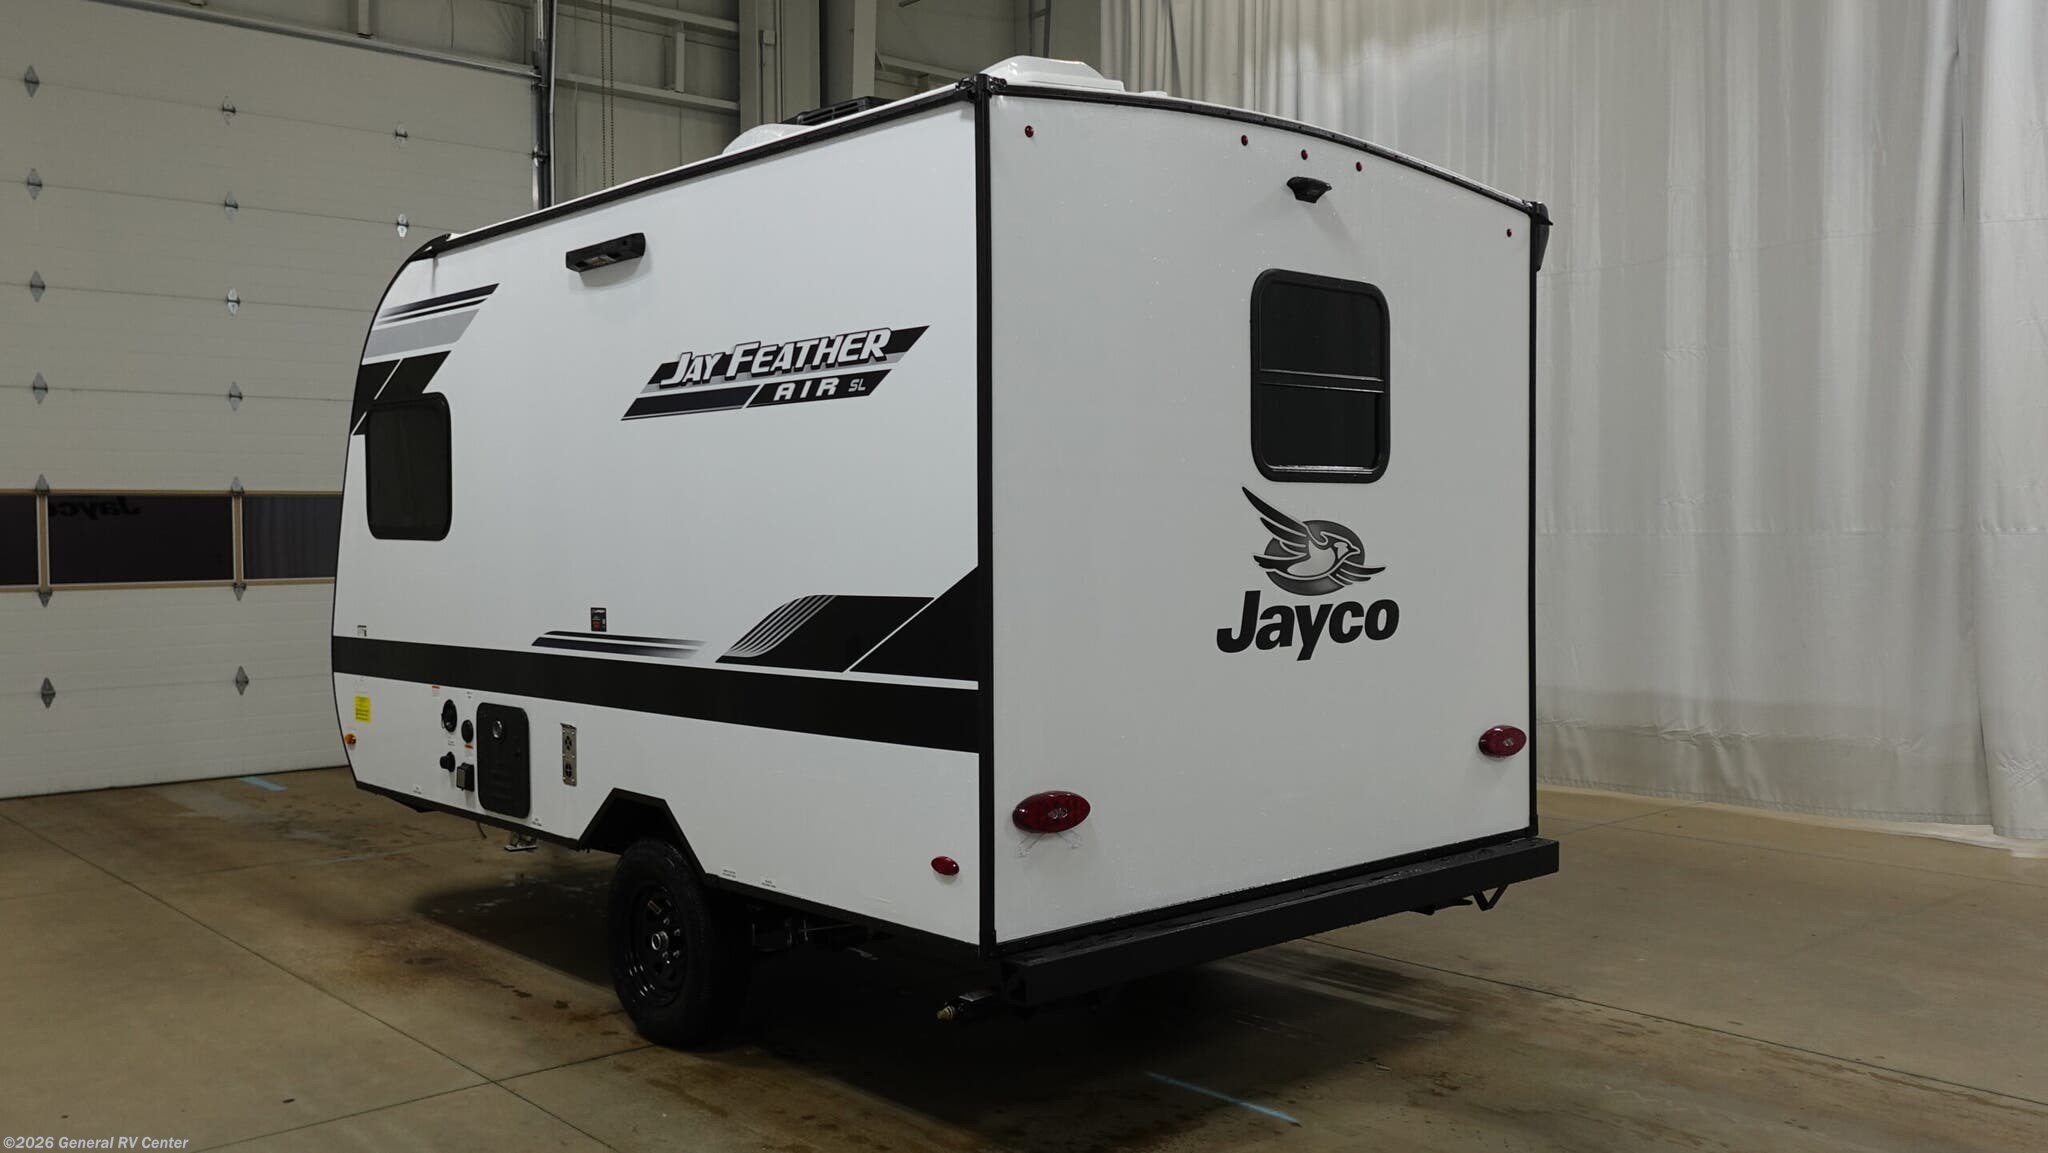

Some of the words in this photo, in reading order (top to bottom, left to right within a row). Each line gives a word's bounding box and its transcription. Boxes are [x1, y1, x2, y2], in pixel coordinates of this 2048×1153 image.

[660, 352, 723, 389] JAY
[724, 327, 892, 381] FEATHER
[773, 377, 840, 402] AIR
[848, 378, 866, 392] SL
[1216, 590, 1400, 662] Jayco
